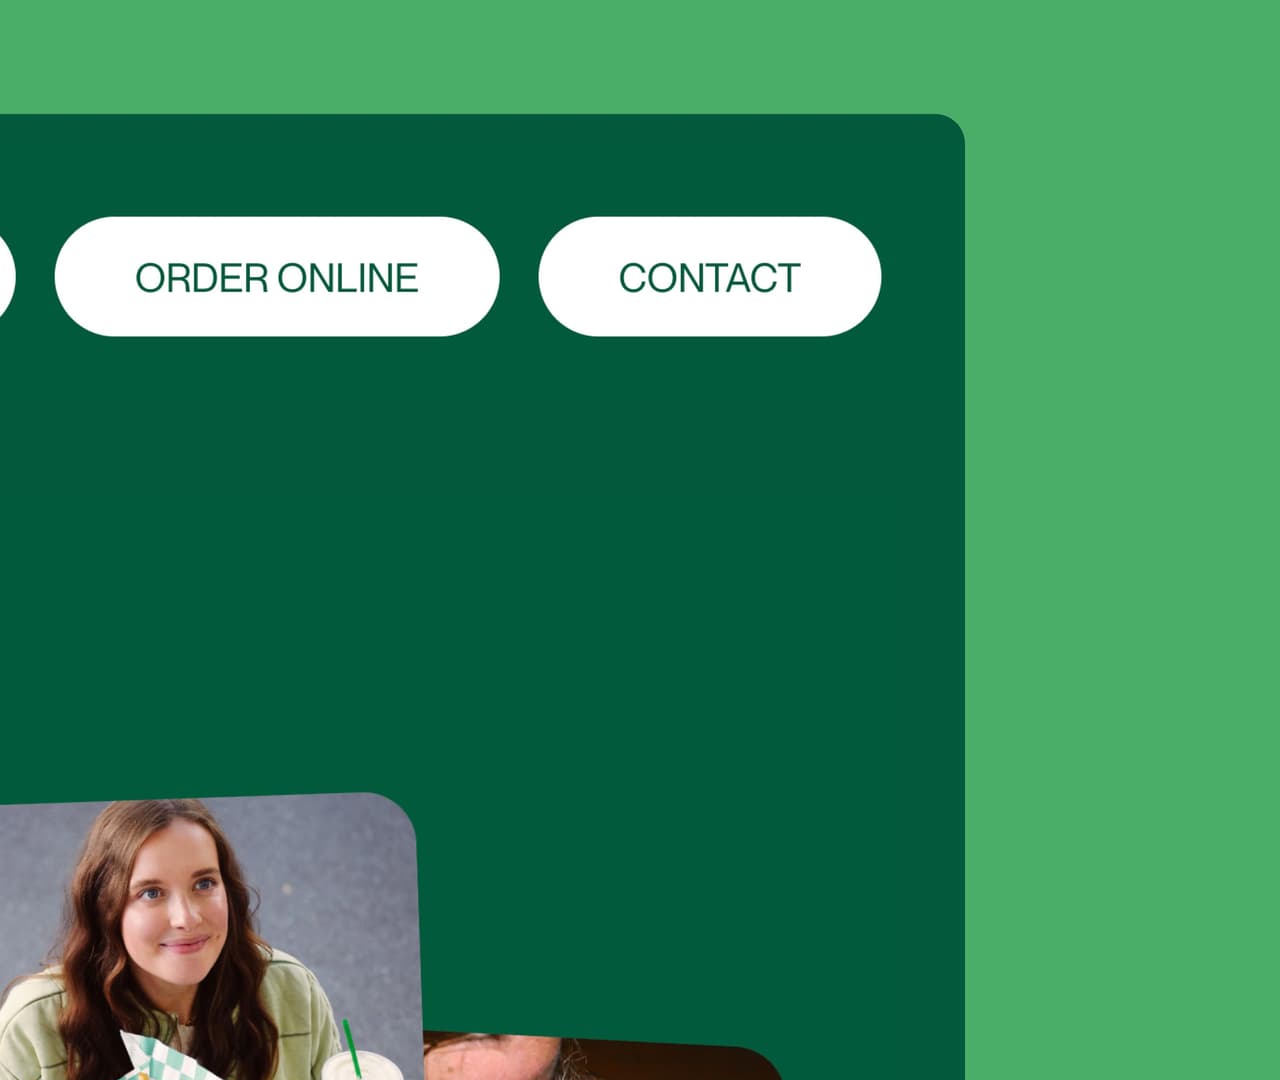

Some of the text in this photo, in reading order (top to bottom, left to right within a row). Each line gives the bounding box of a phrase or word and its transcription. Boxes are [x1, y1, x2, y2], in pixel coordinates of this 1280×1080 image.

[136, 262, 419, 293] ORDER ONLINE
[619, 262, 802, 293] CONTACT
